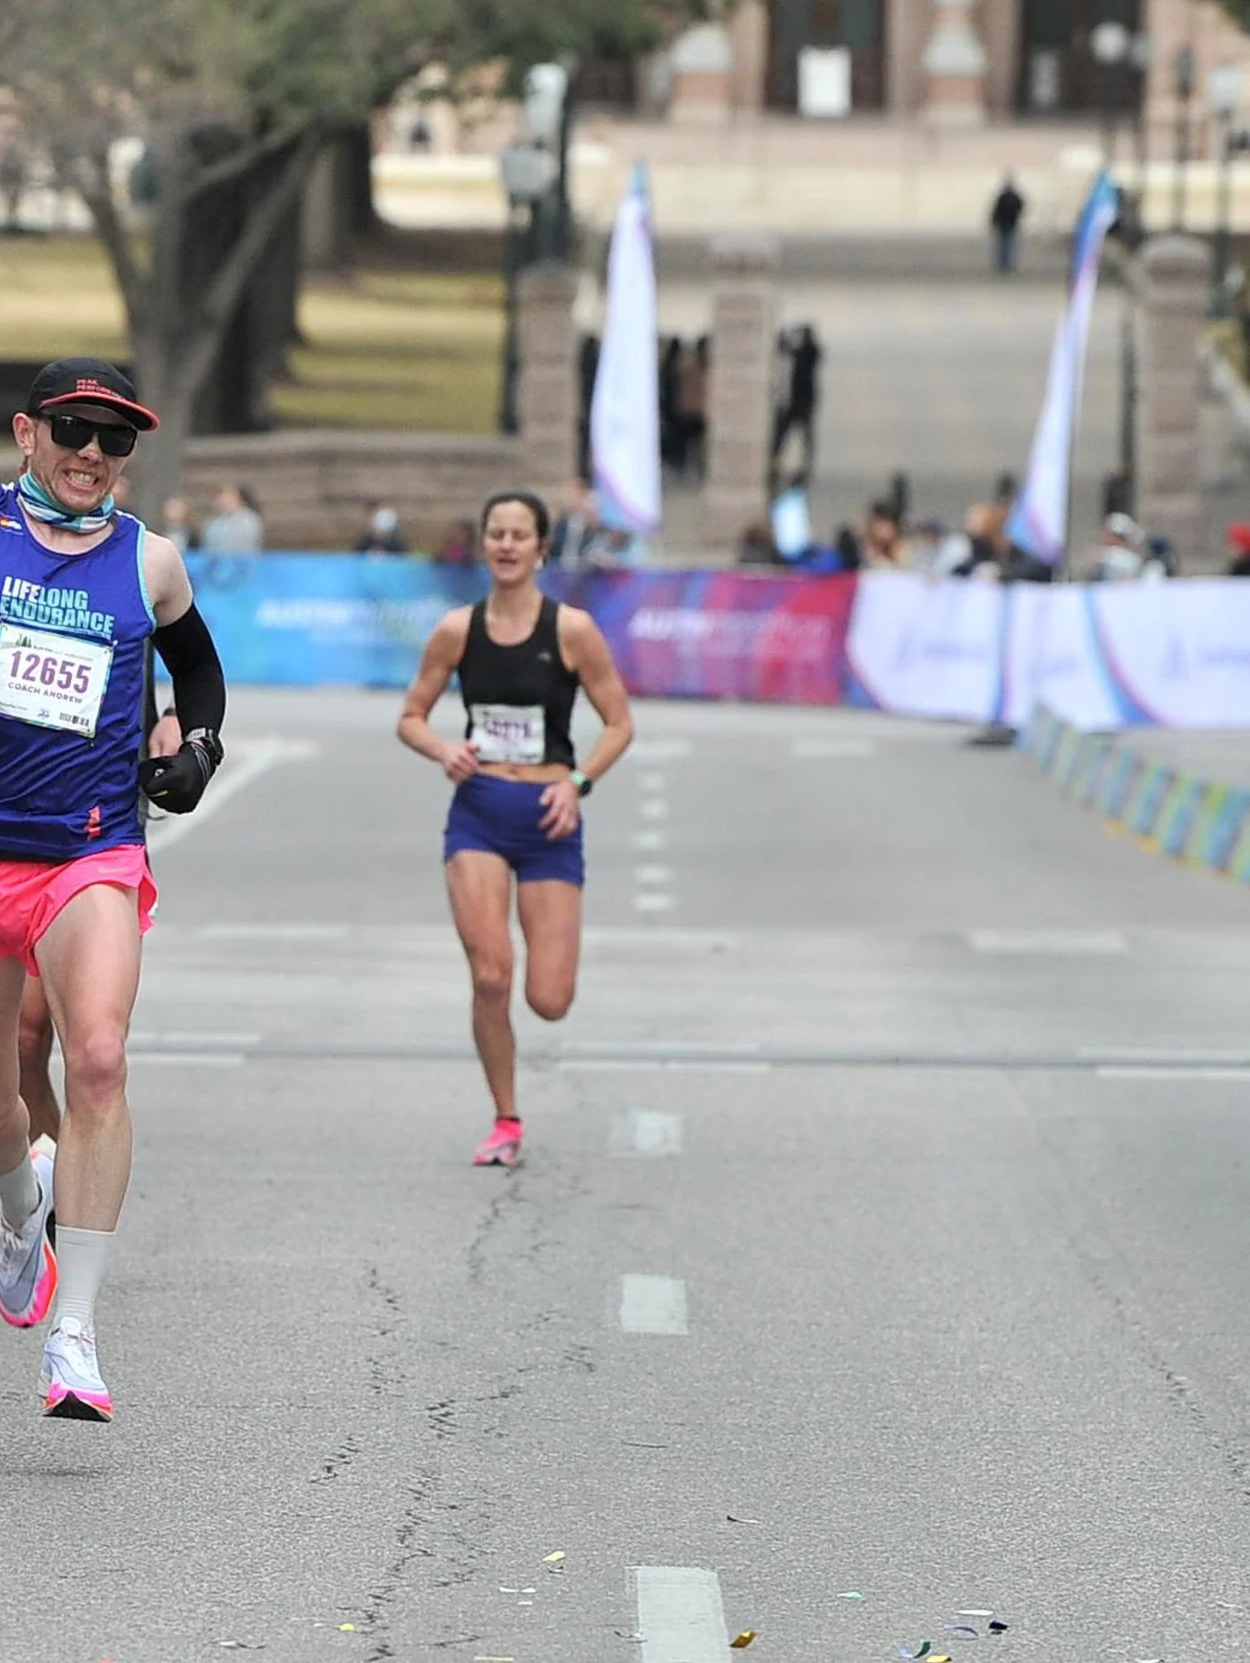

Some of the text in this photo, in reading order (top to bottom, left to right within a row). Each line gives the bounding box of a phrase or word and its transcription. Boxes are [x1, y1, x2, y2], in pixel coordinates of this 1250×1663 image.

[2, 576, 88, 610] LIFELONG
[0, 596, 115, 635] ENDURANCE
[10, 650, 92, 694] 12655
[8, 682, 83, 705] COACH ANDREW
